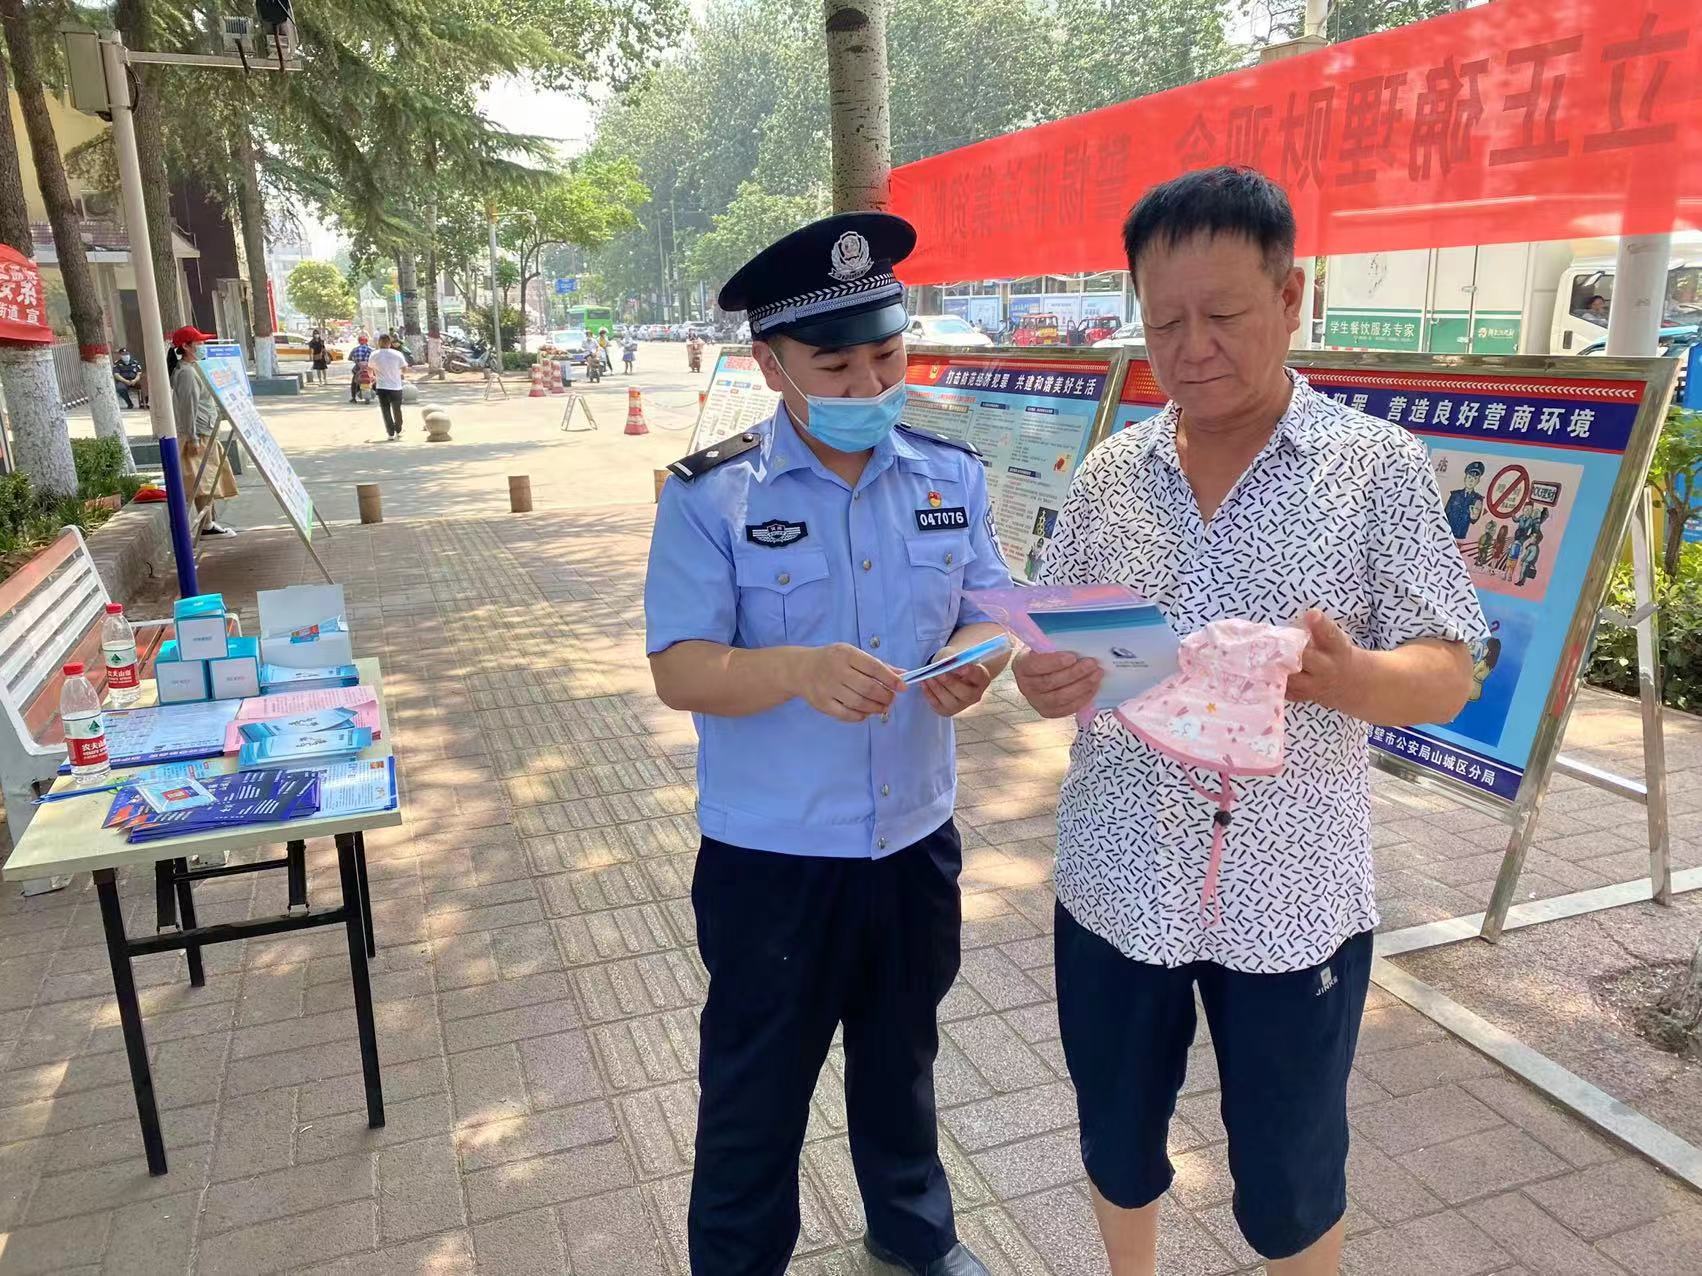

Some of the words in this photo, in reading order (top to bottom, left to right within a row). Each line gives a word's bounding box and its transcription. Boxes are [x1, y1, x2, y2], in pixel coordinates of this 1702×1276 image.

[1330, 320, 1415, 337] 学生餐饮服务专家
[946, 369, 1011, 389] 打击防范经济犯罪
[1015, 374, 1096, 396] 共建和谐美好生活
[1321, 391, 1369, 412] 犯罪
[1387, 395, 1595, 438] 营造良好营商环境
[920, 511, 964, 526] 047076
